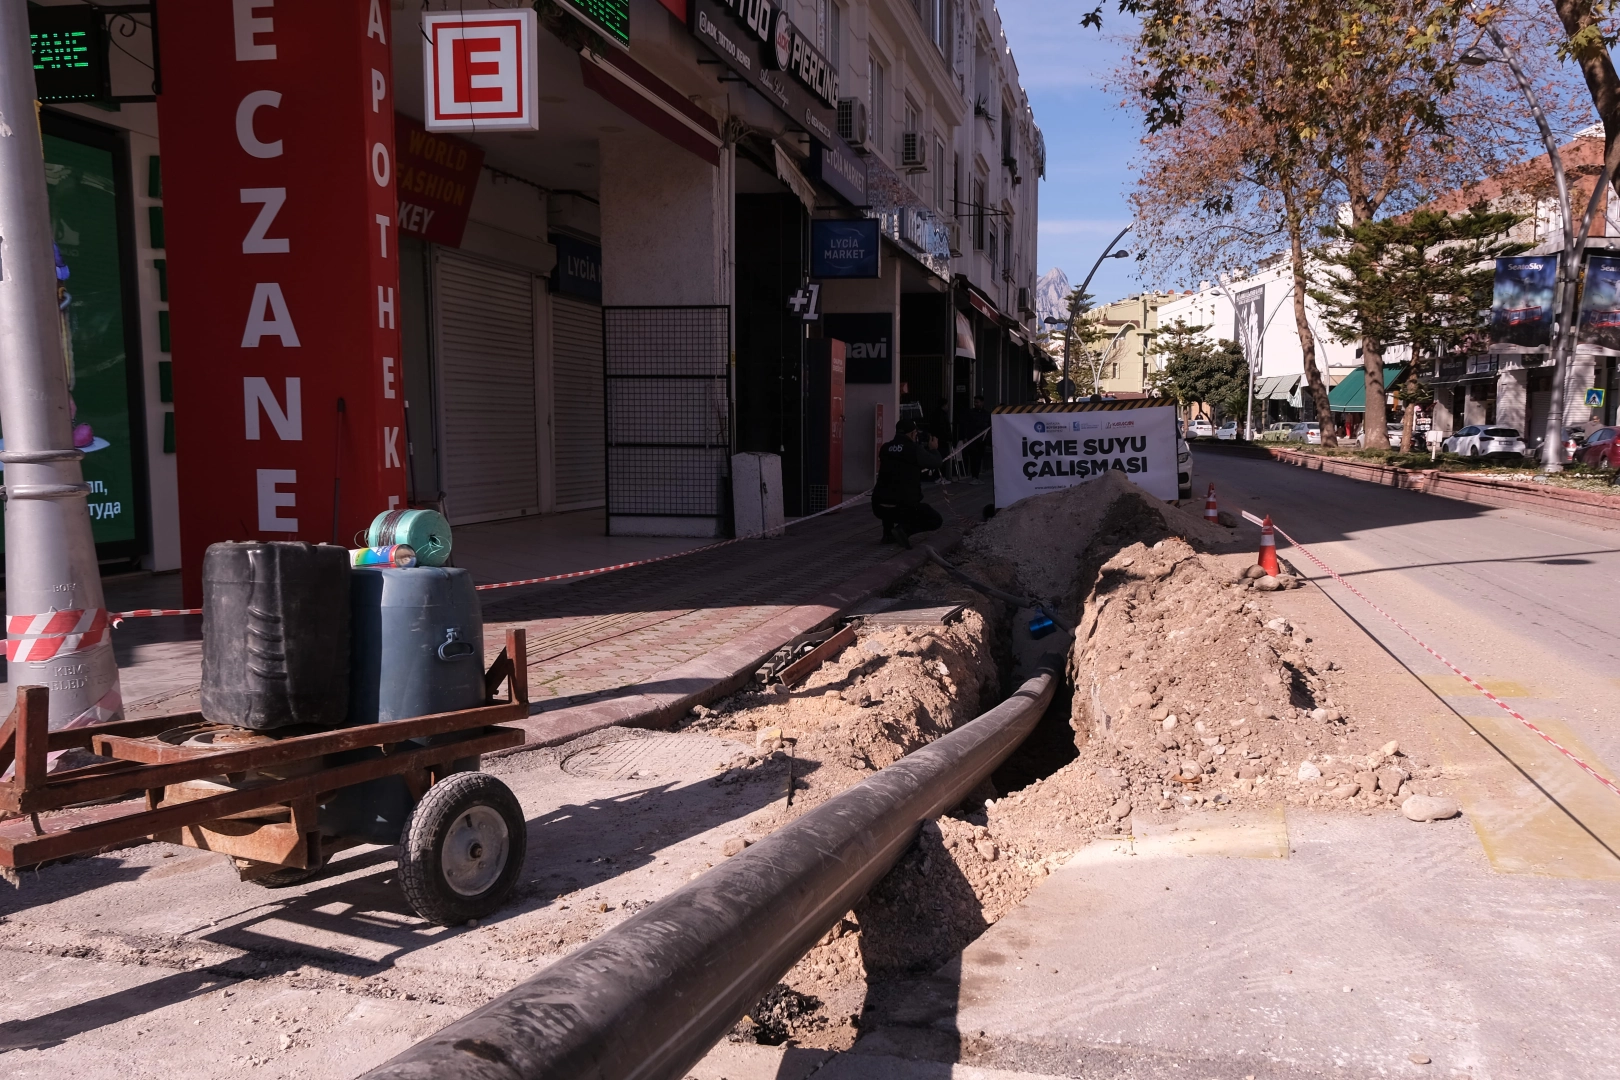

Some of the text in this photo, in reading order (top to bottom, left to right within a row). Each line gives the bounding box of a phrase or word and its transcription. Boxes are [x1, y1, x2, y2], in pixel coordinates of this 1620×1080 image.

[791, 33, 839, 110] PIERCING
[409, 129, 467, 172] WORLD
[824, 249, 865, 260] MARKET
[830, 236, 859, 249] LYCİA
[233, 0, 301, 532] ECZANE
[567, 255, 596, 282] LYCİA
[1021, 436, 1147, 460] İÇME SUYU
[1022, 457, 1148, 482] ÇALIŞMASI
[87, 501, 122, 520] туда
